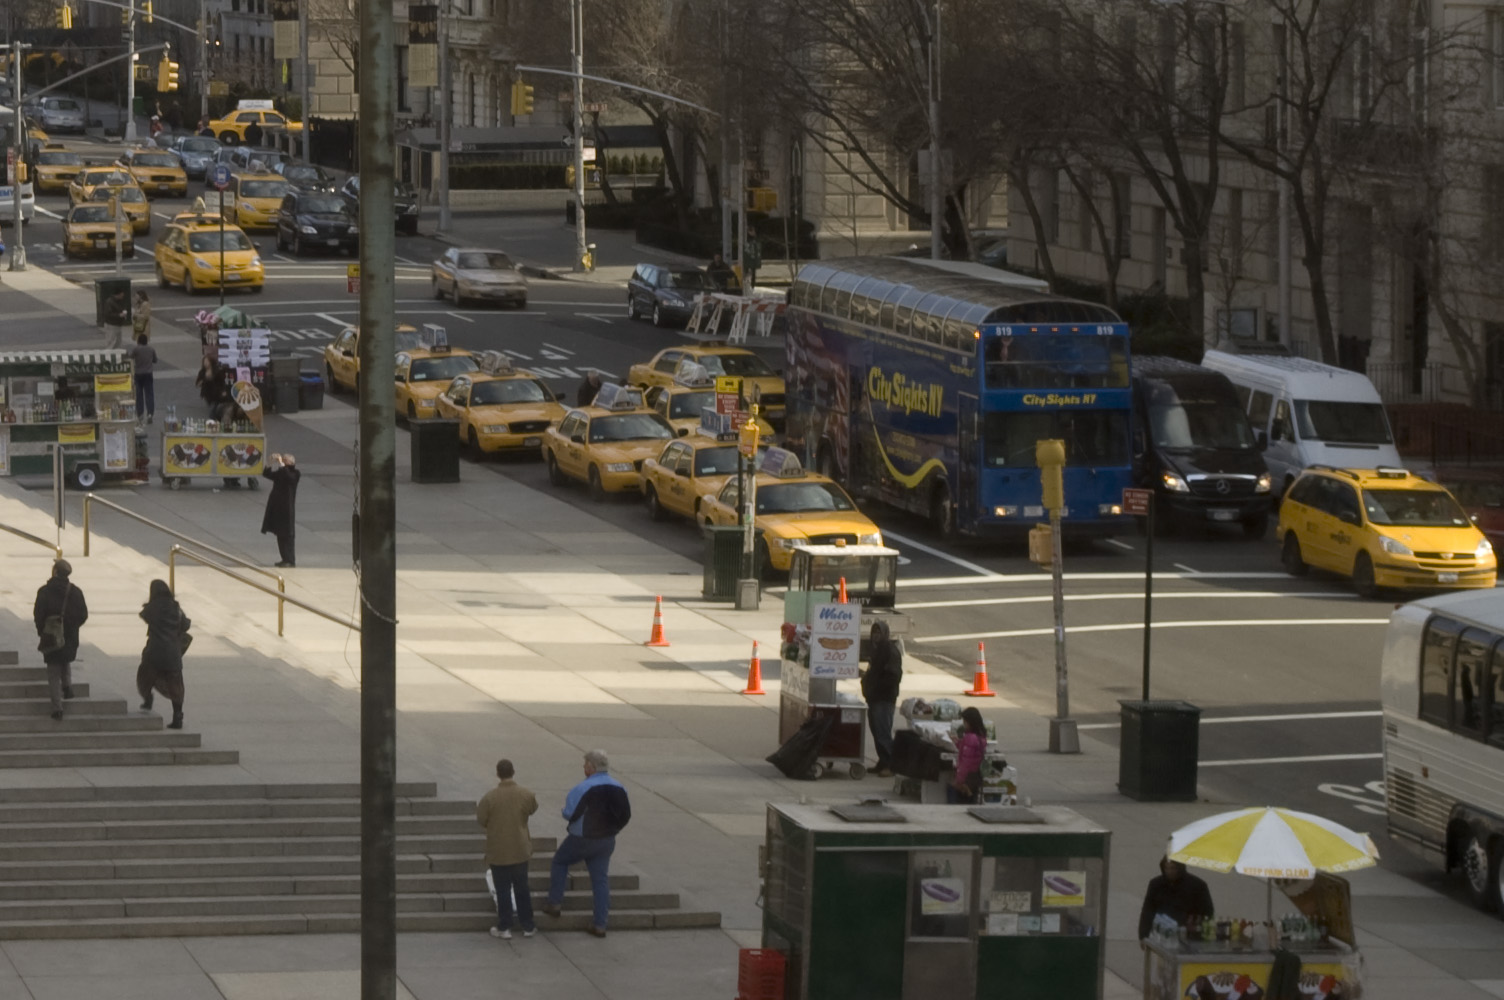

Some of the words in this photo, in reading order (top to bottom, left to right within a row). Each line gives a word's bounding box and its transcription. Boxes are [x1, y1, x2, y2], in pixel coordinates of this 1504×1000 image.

[996, 327, 1012, 336] 819
[1097, 326, 1114, 335] 819
[66, 364, 101, 374] SNACK
[102, 363, 130, 372] STOP
[928, 383, 944, 417] NY
[1082, 394, 1098, 404] NY
[819, 607, 854, 620] Water
[1285, 869, 1310, 878] CLEAN
